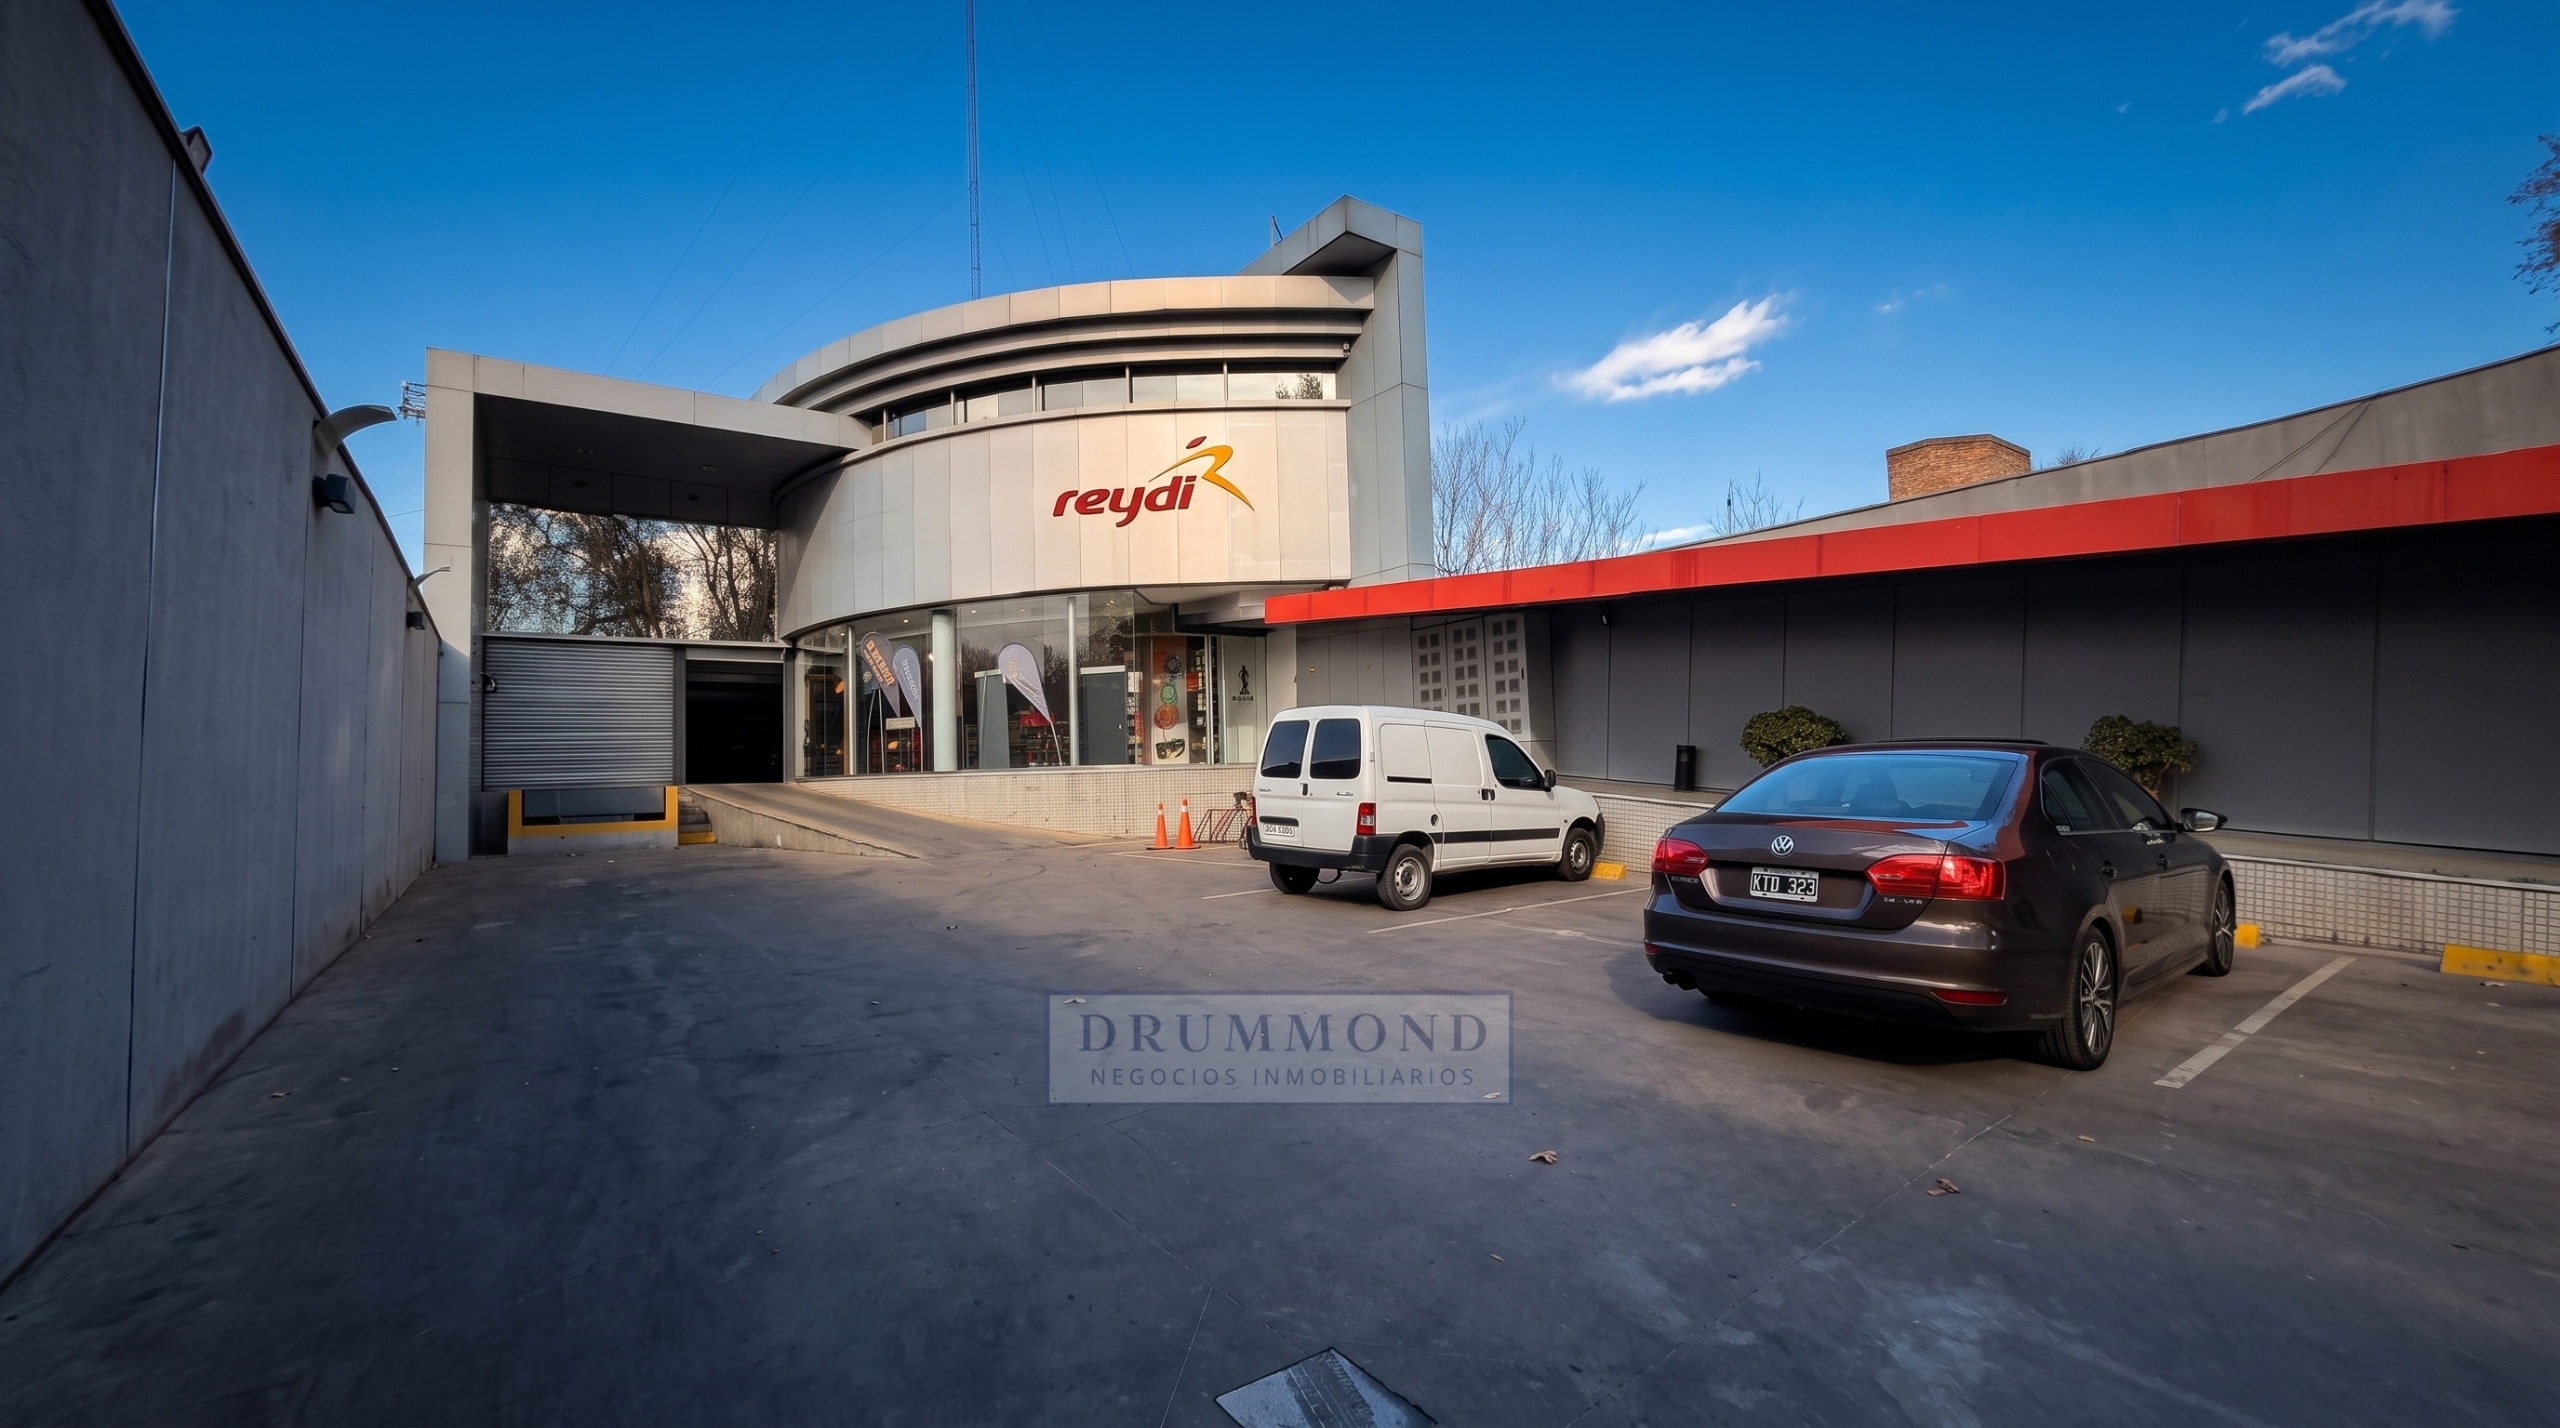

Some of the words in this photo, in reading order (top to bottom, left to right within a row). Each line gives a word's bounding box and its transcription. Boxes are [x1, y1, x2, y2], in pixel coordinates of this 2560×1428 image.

[1052, 475, 1197, 528] reydi
[1752, 874, 1780, 893] KTD
[1787, 877, 1816, 896] 323
